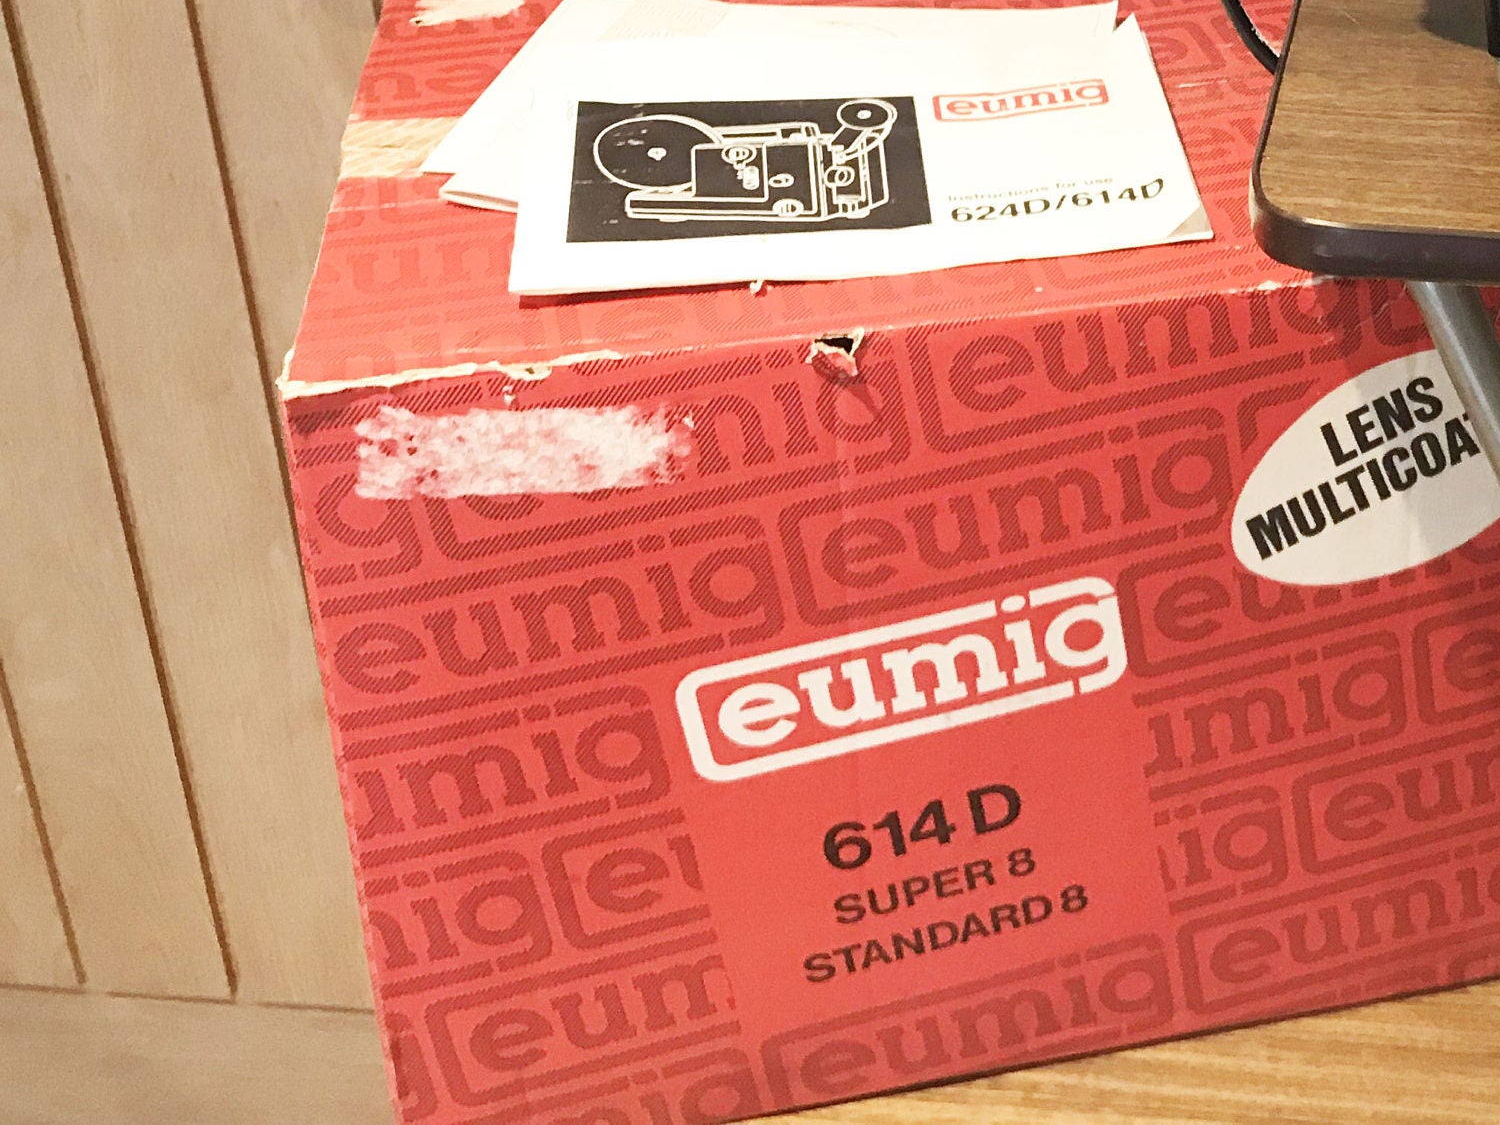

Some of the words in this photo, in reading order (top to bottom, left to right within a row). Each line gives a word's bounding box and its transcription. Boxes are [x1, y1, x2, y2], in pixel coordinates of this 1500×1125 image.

[944, 79, 1109, 117] eumig
[951, 178, 1164, 223] 624D/614D
[1320, 377, 1444, 467] LENS
[821, 421, 1232, 588] eumig
[333, 525, 786, 695] eumig
[716, 579, 1128, 748] eumig
[823, 799, 956, 869] 614
[967, 784, 1022, 836] D
[833, 859, 995, 924] SUPER
[1007, 847, 1036, 877] 8
[803, 895, 1053, 982] STANDARD
[1061, 884, 1089, 913] 8
[802, 951, 1174, 1097] eumig
